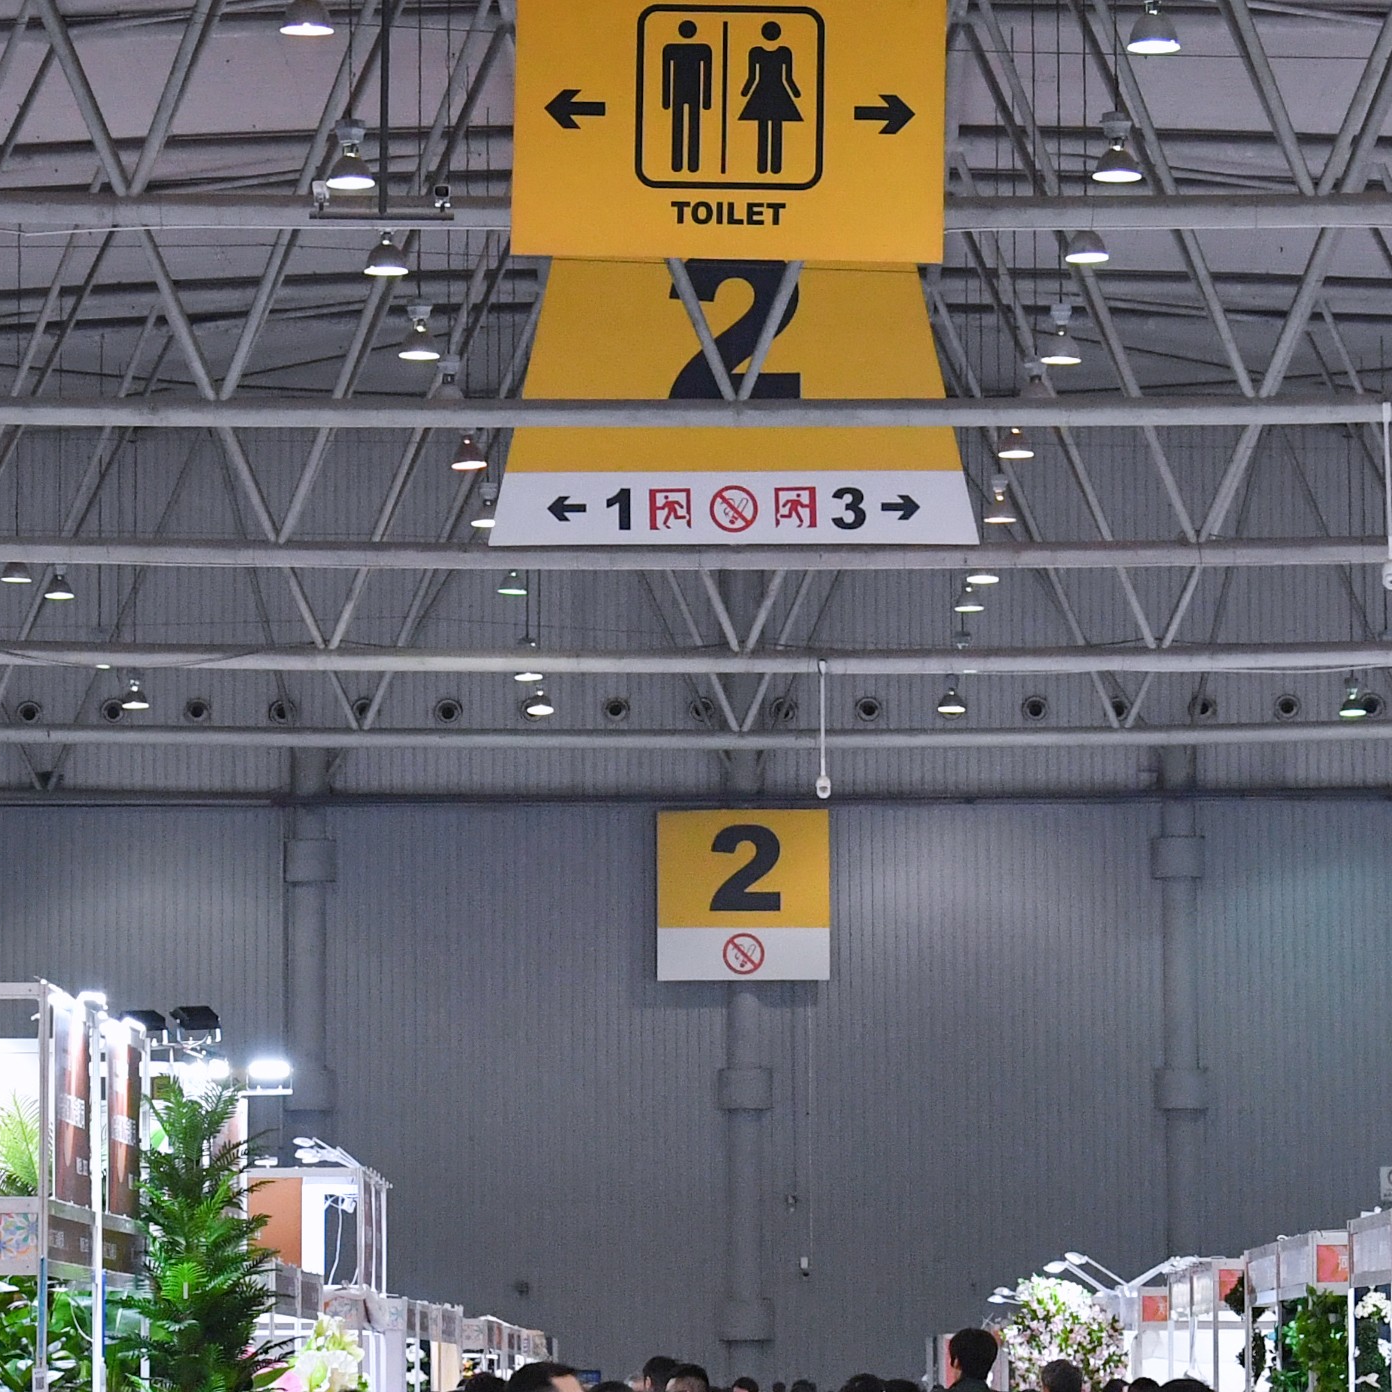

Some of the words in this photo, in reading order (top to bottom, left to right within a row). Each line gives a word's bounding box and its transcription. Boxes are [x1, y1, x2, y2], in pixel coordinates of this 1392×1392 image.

[671, 201, 786, 225] TOILET
[668, 258, 801, 399] 2
[606, 487, 631, 531] 1
[831, 486, 866, 530] 3
[709, 824, 781, 912] 2
